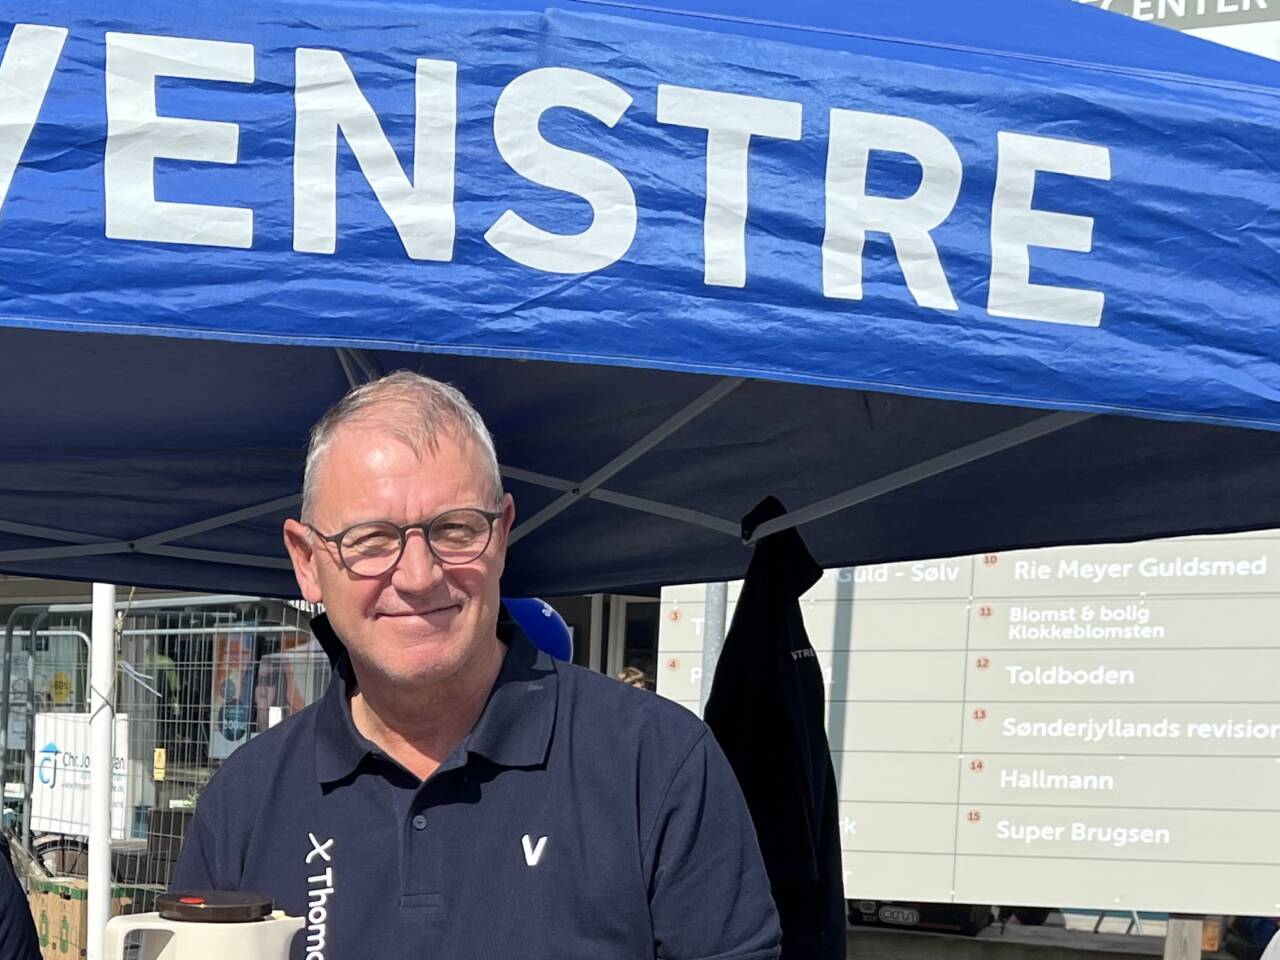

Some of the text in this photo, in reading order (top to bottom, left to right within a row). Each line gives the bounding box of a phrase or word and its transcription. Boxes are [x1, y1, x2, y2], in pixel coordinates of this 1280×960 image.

[983, 554, 998, 565] 10
[911, 562, 961, 583] Sølv
[1014, 556, 1267, 583] Rie Meyer Guldsmed
[980, 607, 992, 617] 11
[1010, 605, 1150, 624] Blomst & bolig
[1009, 623, 1165, 640] Klokkeblomsten
[976, 659, 989, 669] 12
[1005, 665, 1135, 685] Toldboden
[974, 710, 986, 719] 13
[1003, 717, 1181, 741] Sønderjyllands
[970, 761, 983, 770] 14
[1000, 769, 1114, 790] Hallmann
[968, 812, 980, 821] 15
[996, 820, 1170, 847] Super Brugsen
[305, 832, 334, 864] X
[521, 833, 548, 867] V
